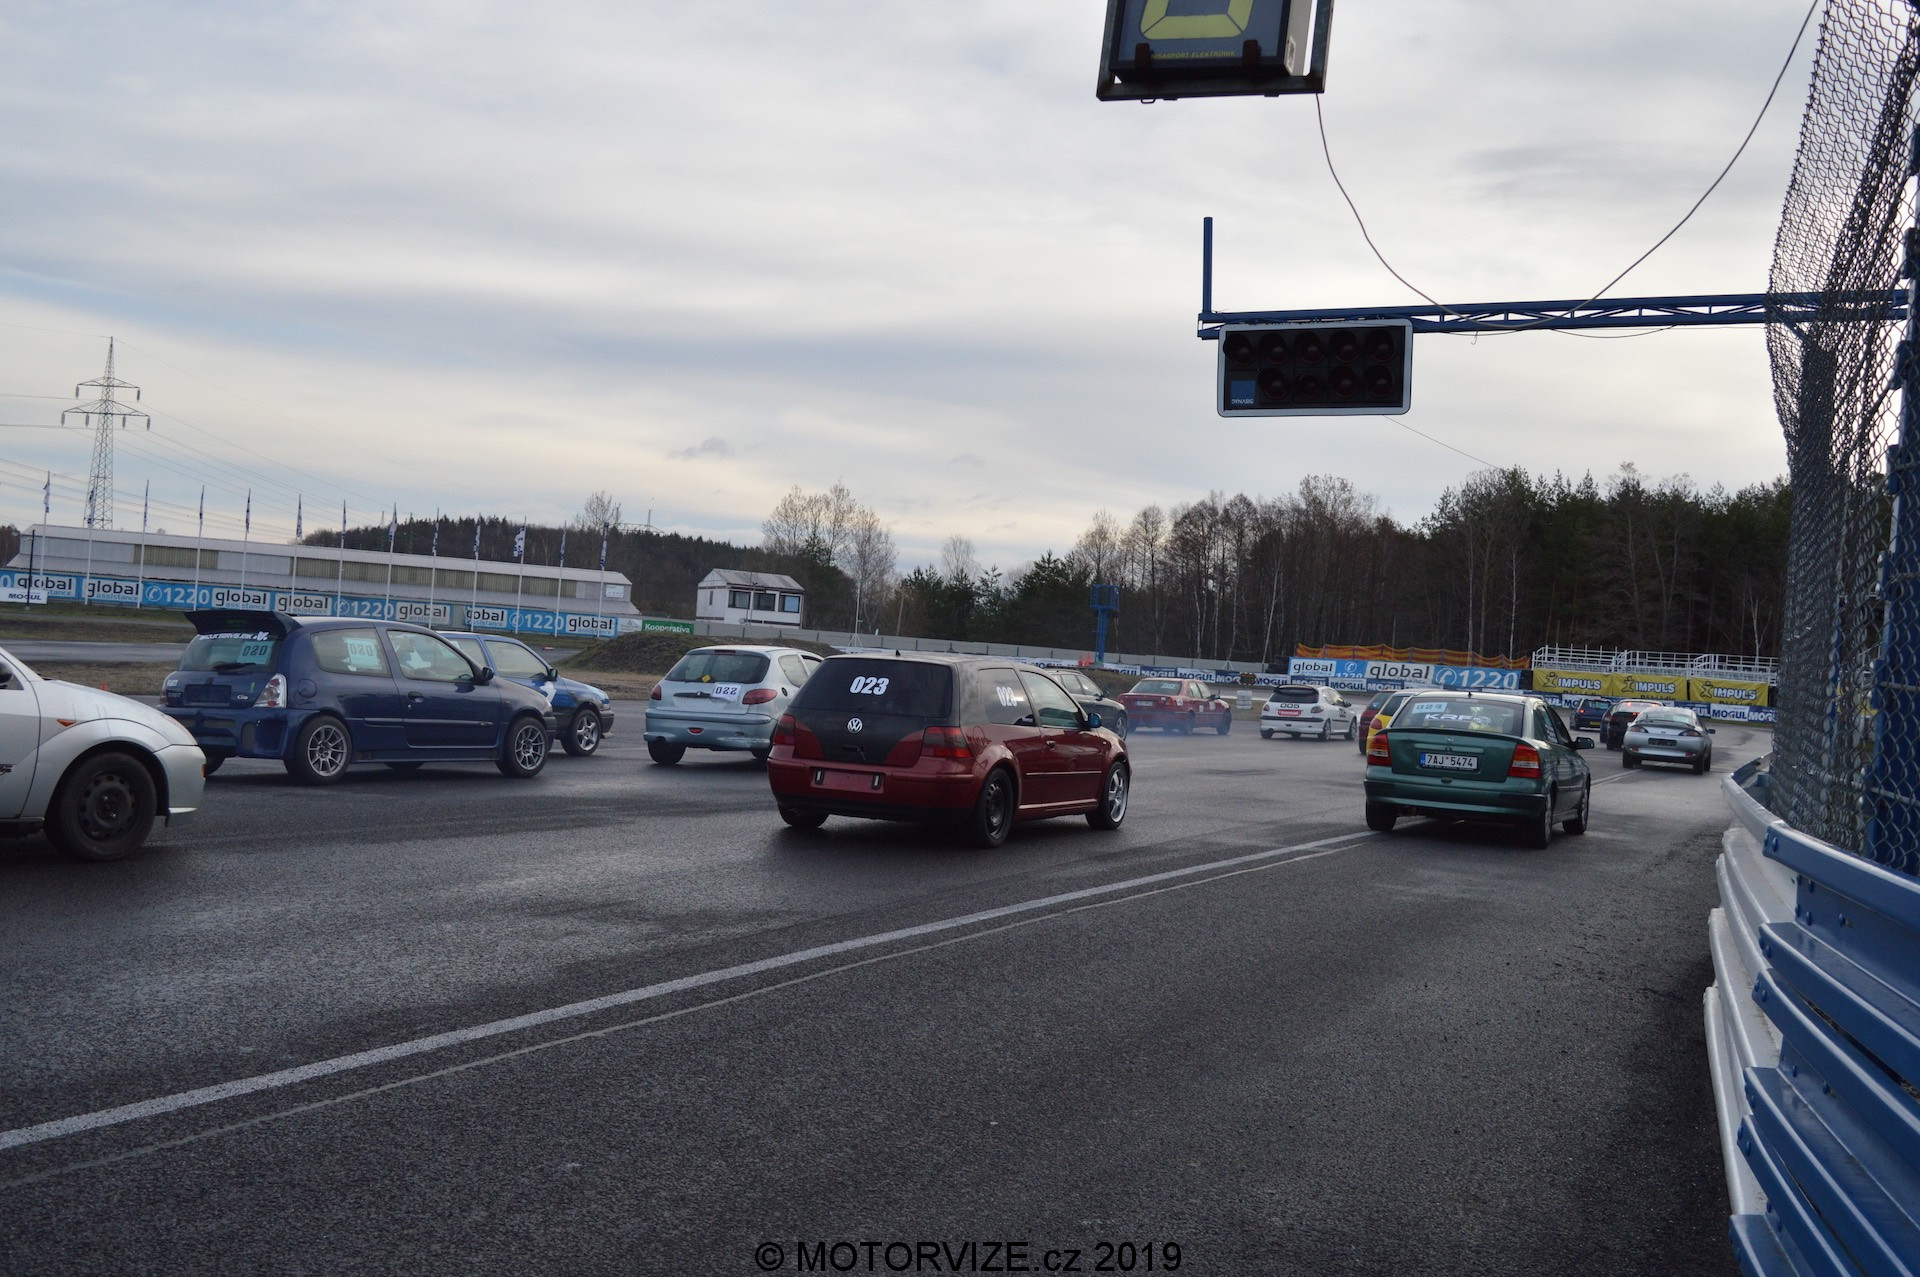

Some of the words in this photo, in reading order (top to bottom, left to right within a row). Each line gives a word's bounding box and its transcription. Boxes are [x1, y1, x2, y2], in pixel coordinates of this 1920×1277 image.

[87, 580, 139, 597] global
[164, 587, 210, 604] 1220
[215, 589, 267, 607] global
[278, 595, 329, 612] global
[351, 600, 395, 618] 1220
[399, 603, 447, 620] global
[524, 613, 565, 630] 1220
[568, 616, 613, 632] global
[645, 623, 690, 634] Kooperativa
[242, 645, 268, 657] 020
[1293, 662, 1333, 674] global
[1179, 672, 1215, 682] MOGUL
[1460, 669, 1518, 690] 1220
[1558, 677, 1602, 691] IMPULS
[715, 686, 738, 696] 022
[850, 676, 889, 696] 023
[1330, 680, 1366, 691] MOGUL
[1635, 682, 1676, 694] IMPULS
[996, 686, 1018, 708] 023
[1713, 687, 1758, 701] IMPULS
[1712, 708, 1748, 719] MOGUL
[1427, 754, 1444, 766] 7AJ
[1450, 757, 1473, 768] 5474
